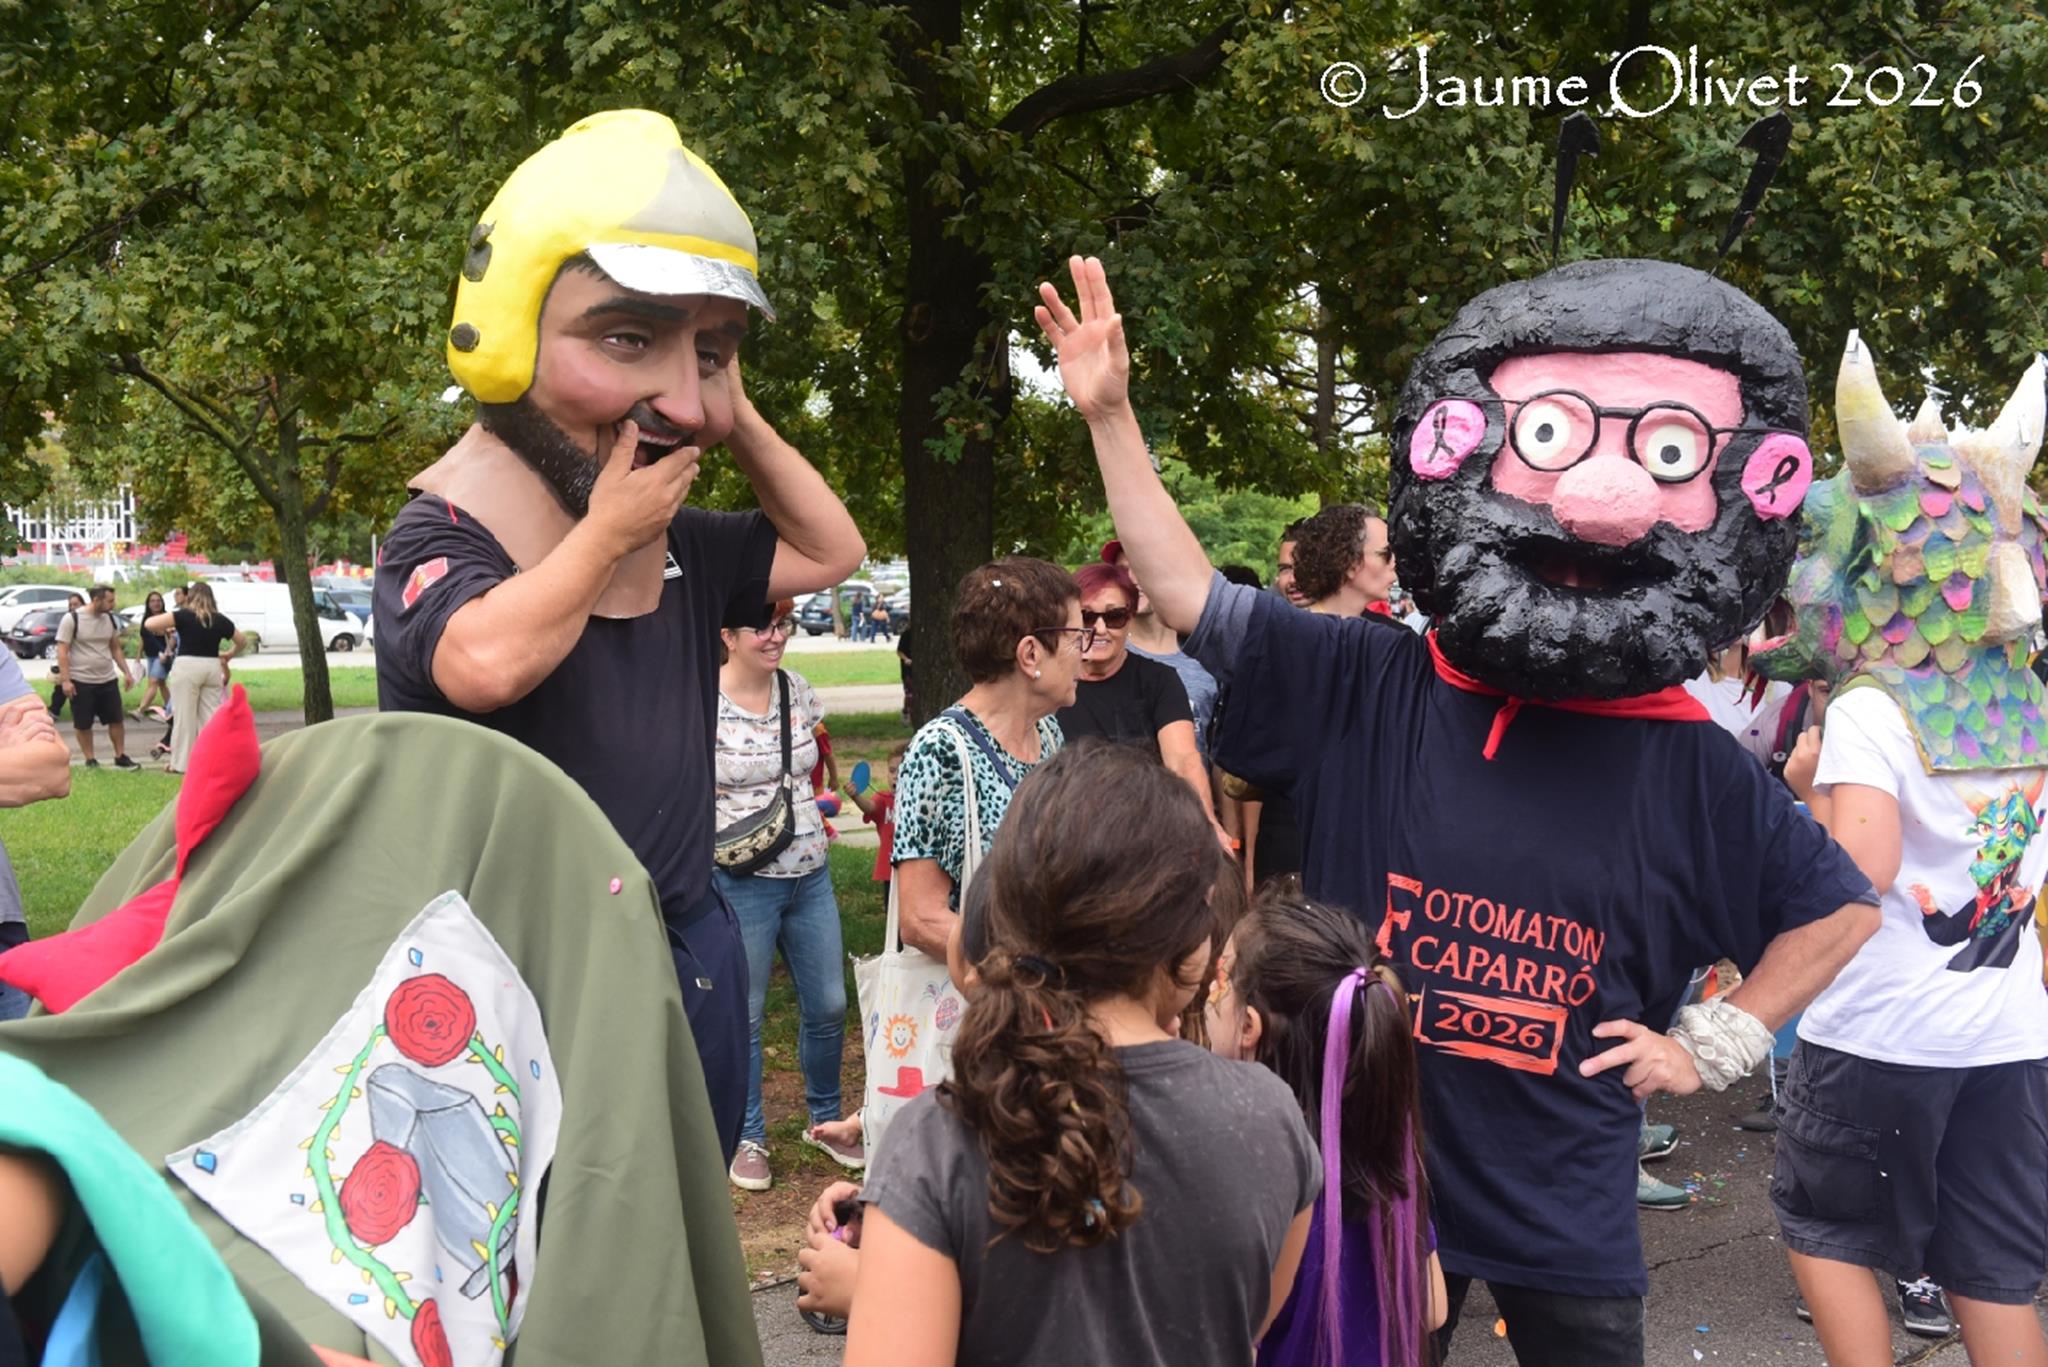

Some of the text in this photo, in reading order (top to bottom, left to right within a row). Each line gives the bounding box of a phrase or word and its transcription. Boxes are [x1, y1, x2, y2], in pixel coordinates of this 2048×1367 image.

[1375, 872, 1605, 965] FOTOMATON
[1411, 935, 1596, 1006] CAPARRÓ
[1435, 1003, 1545, 1050] 2026
